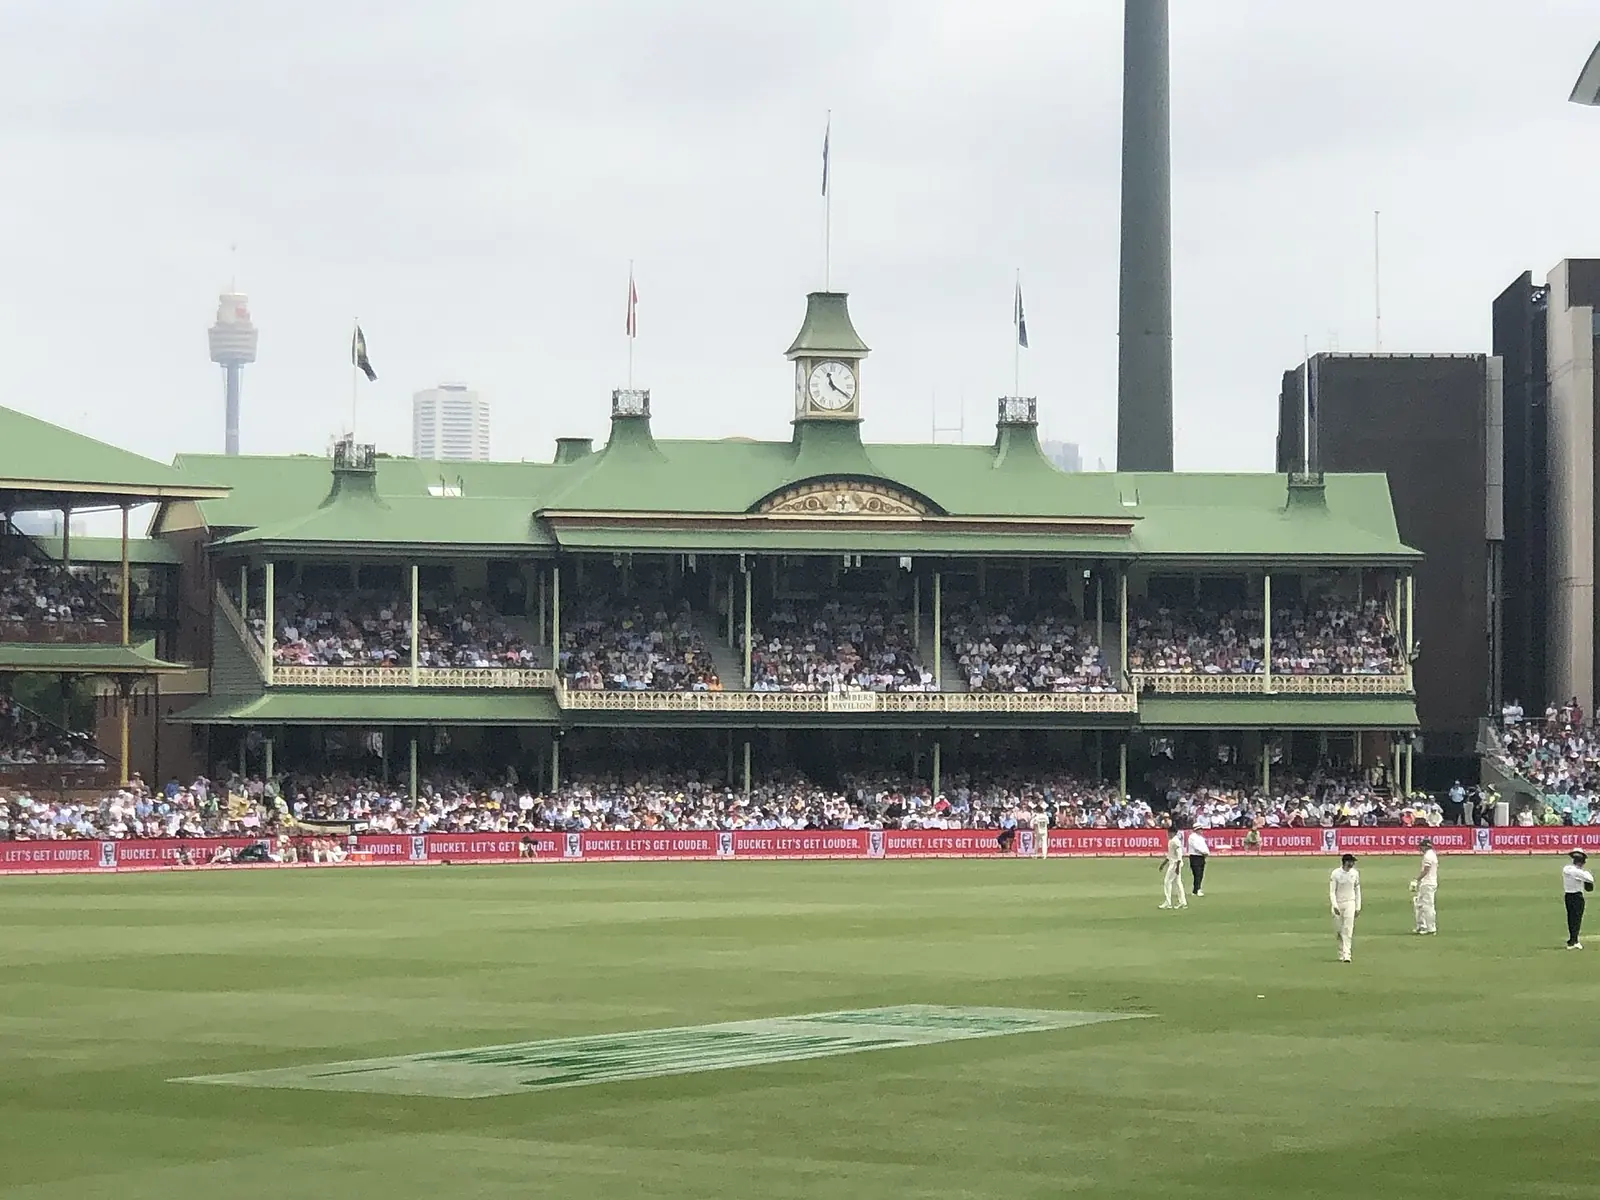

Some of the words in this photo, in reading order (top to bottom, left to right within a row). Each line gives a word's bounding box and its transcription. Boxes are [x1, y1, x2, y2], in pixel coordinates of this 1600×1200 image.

[832, 702, 872, 710] PAVILION
[585, 840, 624, 851] BUCKET.
[625, 839, 651, 851] LET'S
[653, 839, 670, 850] GET
[672, 839, 711, 850] LOUDER.
[737, 839, 774, 850] BUCKET.
[776, 838, 802, 850] LET'S
[803, 838, 821, 849] GET
[822, 838, 861, 849] LOUDER.
[887, 838, 926, 849] BUCKET.
[927, 837, 953, 849] LET'S
[955, 837, 973, 849] GET
[1077, 837, 1103, 848] LET'S
[1105, 837, 1122, 848] GET
[1124, 837, 1162, 848] LOUDER.
[1276, 836, 1315, 847] LOUDER.
[1341, 835, 1379, 846] BUCKET.
[1381, 835, 1406, 846] LET'S
[1494, 835, 1534, 845] BUCKET.
[1536, 834, 1559, 845] LET'S
[1561, 834, 1579, 845] GET
[1581, 834, 1600, 845] LOU
[430, 842, 468, 853] BUCKET.
[471, 841, 496, 853] LET'S
[498, 841, 516, 852] GET
[5, 850, 31, 862] LET'S
[33, 850, 51, 861] GET
[53, 849, 94, 861] LOUDER.
[120, 848, 158, 860] BUCKET.
